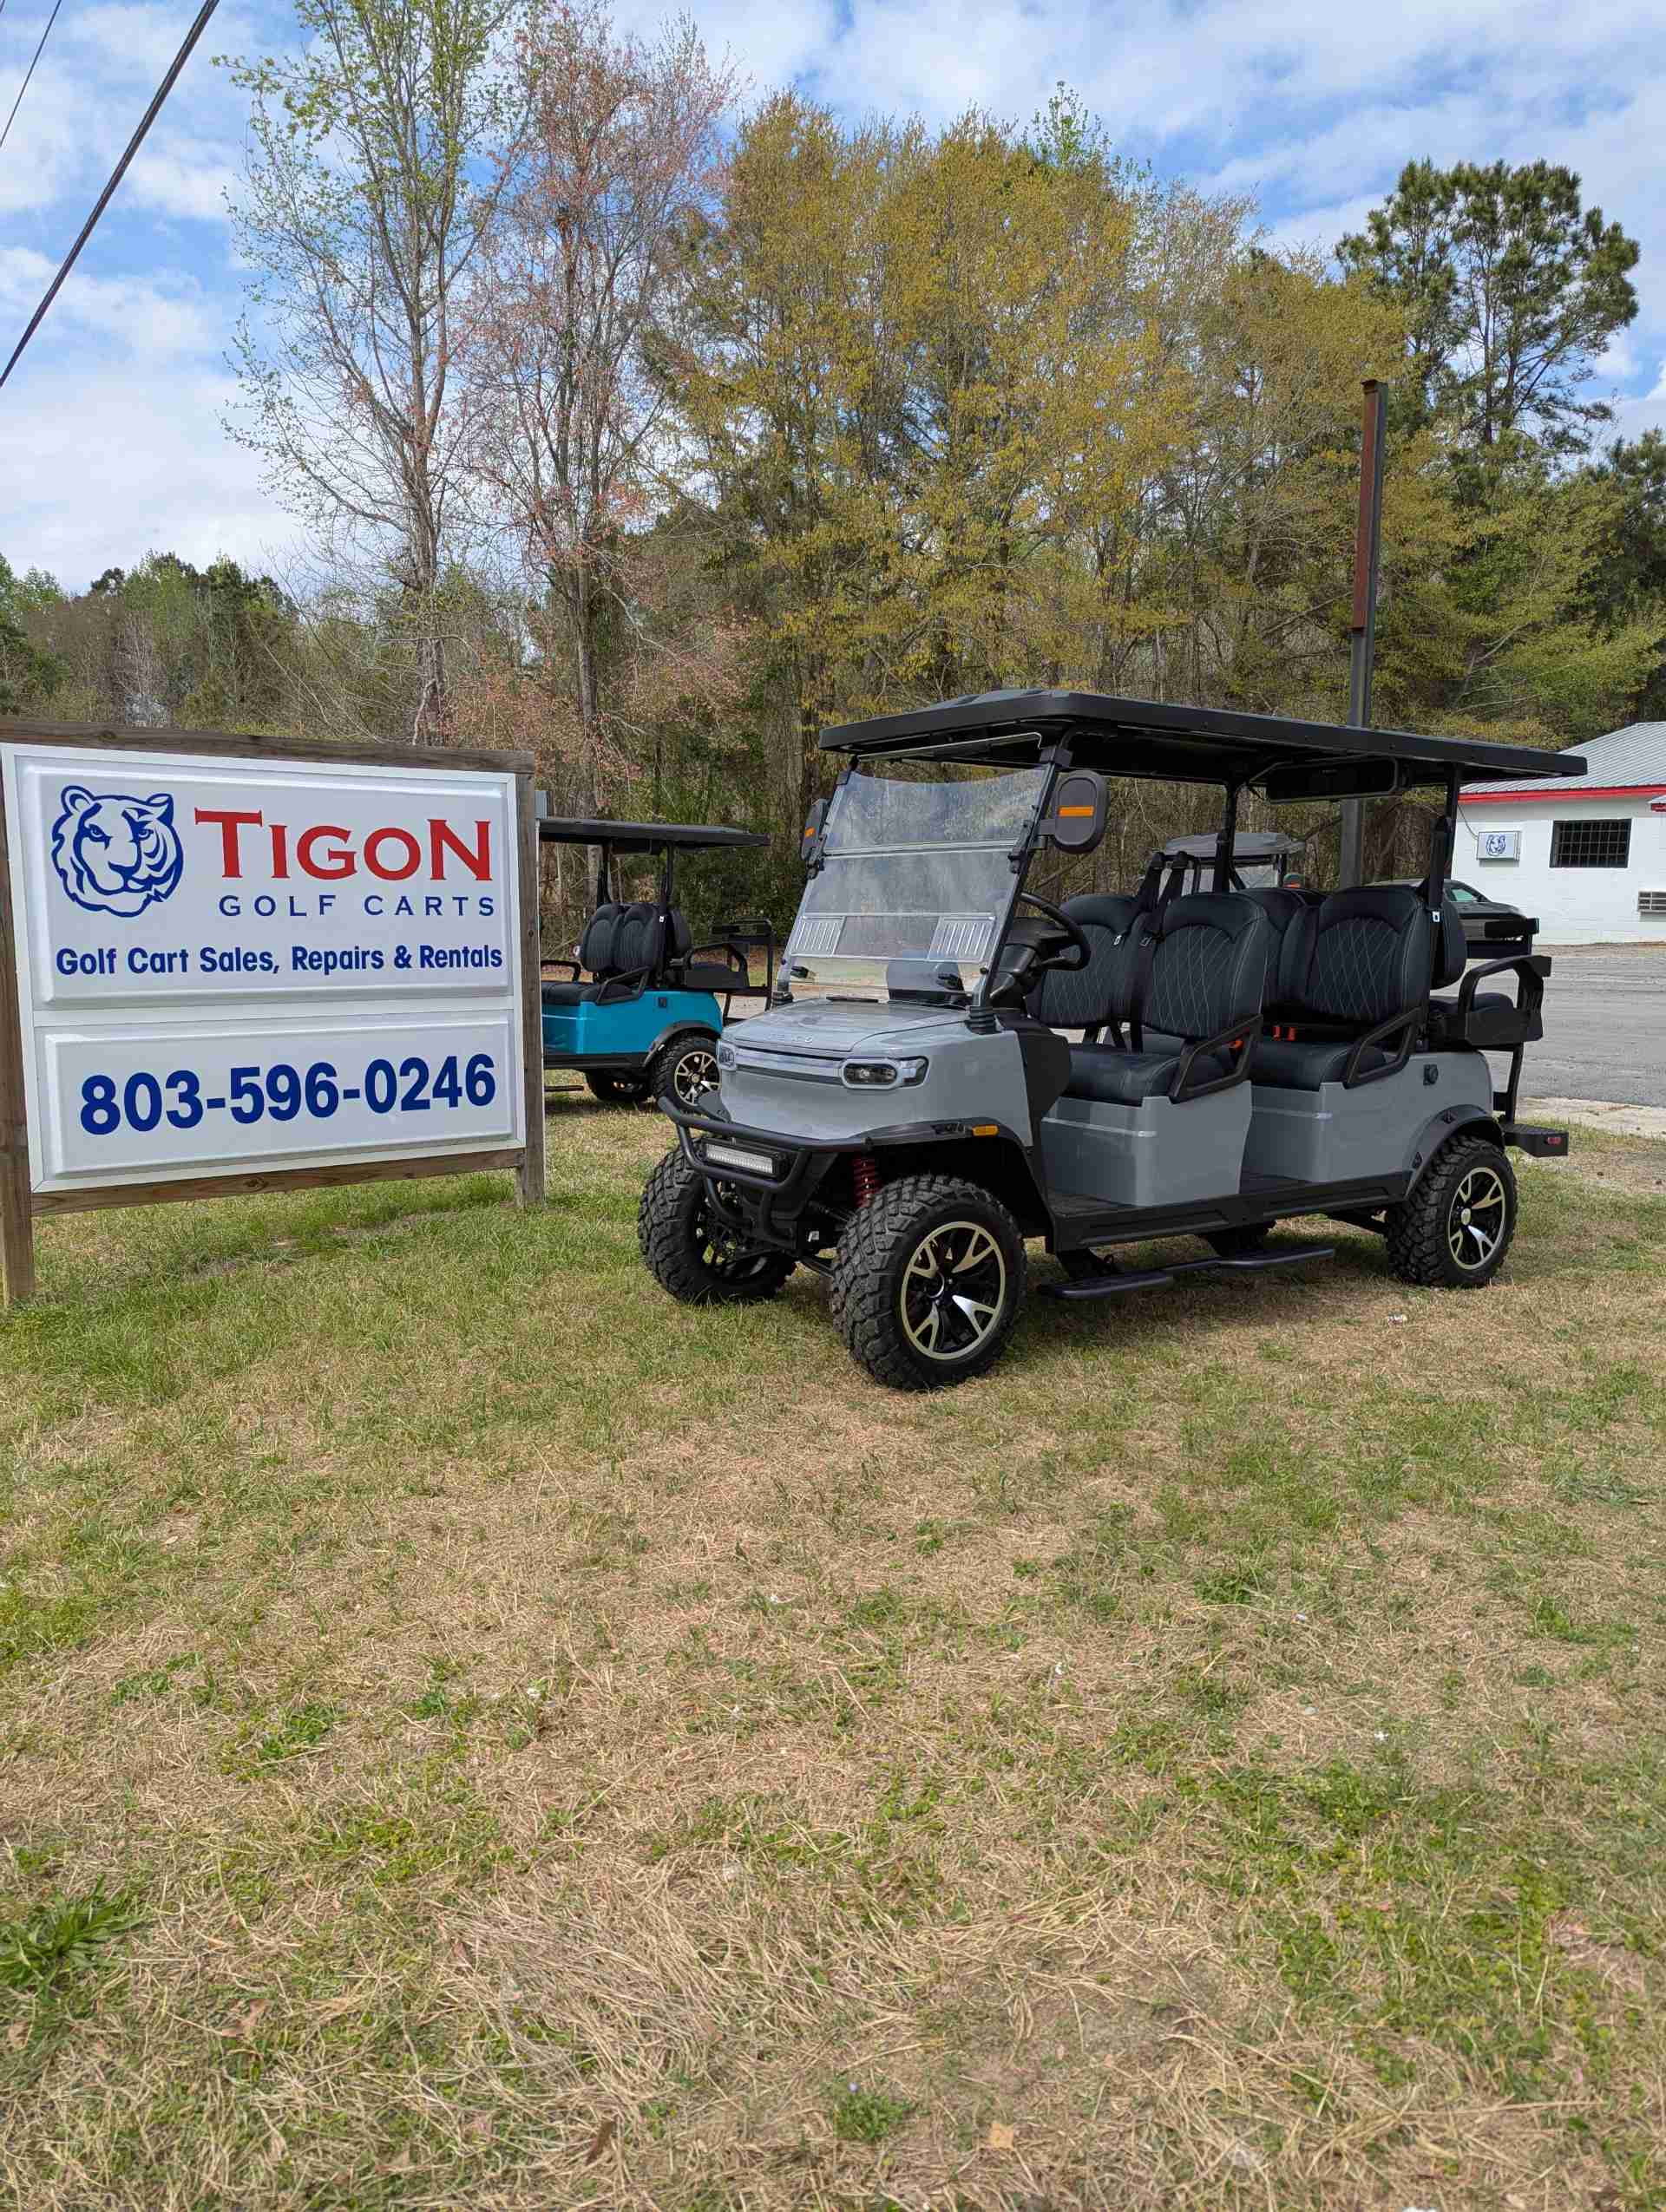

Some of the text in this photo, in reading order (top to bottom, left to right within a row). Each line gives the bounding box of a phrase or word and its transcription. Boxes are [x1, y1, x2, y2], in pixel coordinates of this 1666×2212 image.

[193, 807, 494, 881] TIGON
[219, 894, 495, 917] GOLF CARTS
[56, 944, 503, 976] Golf Cart Sales, Repairs & Rentals
[80, 1053, 497, 1135] 803-596-0246
